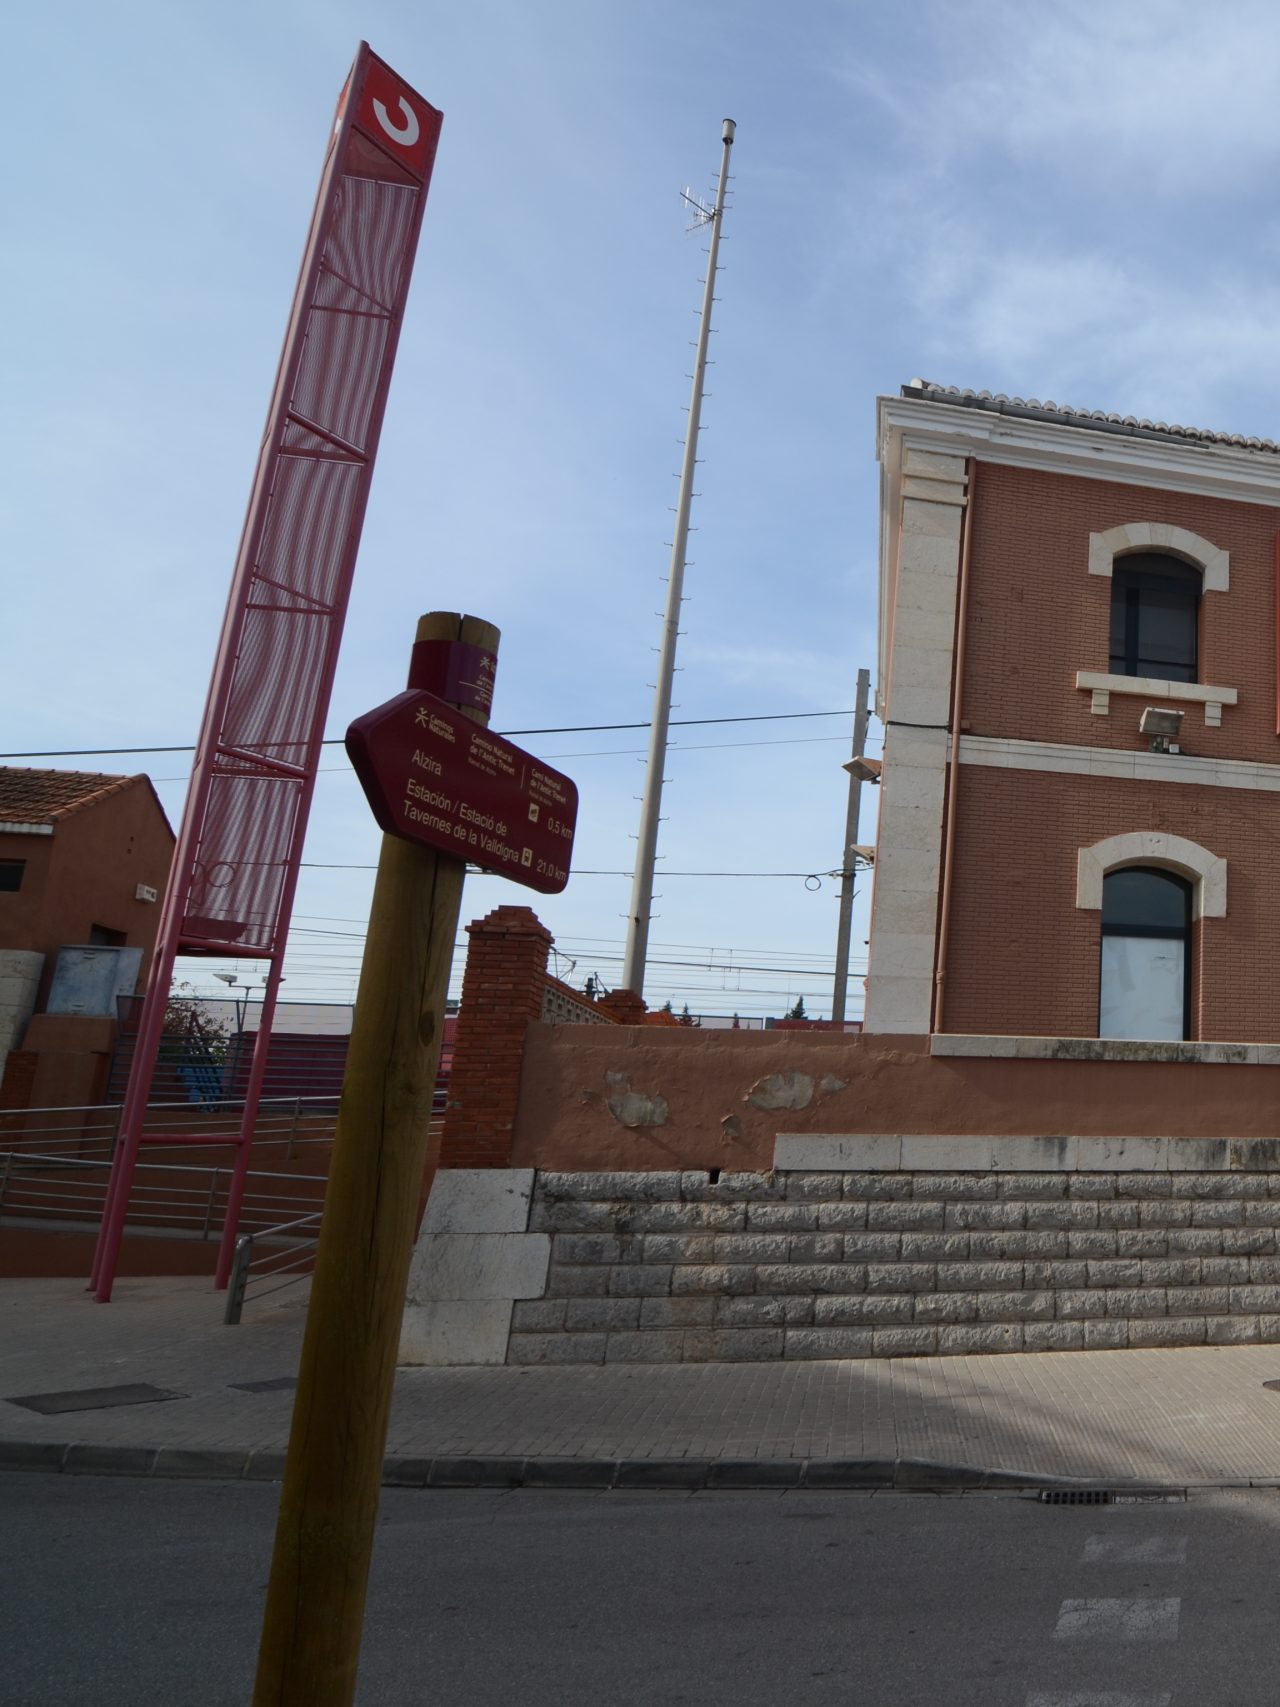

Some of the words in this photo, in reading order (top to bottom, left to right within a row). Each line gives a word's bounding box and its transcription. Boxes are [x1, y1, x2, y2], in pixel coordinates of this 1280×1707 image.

[430, 714, 454, 734] Caminos
[411, 749, 442, 776] Alzira
[407, 778, 451, 812] Estación
[460, 802, 494, 831] Estació
[495, 820, 508, 837] de
[404, 799, 452, 834] Tavernes
[453, 823, 467, 840] de
[468, 828, 478, 846] la
[480, 832, 519, 862] Valldigna
[547, 817, 560, 834] 0,5
[561, 823, 573, 840] km
[536, 858, 554, 877] 21,0
[555, 866, 567, 882] km
